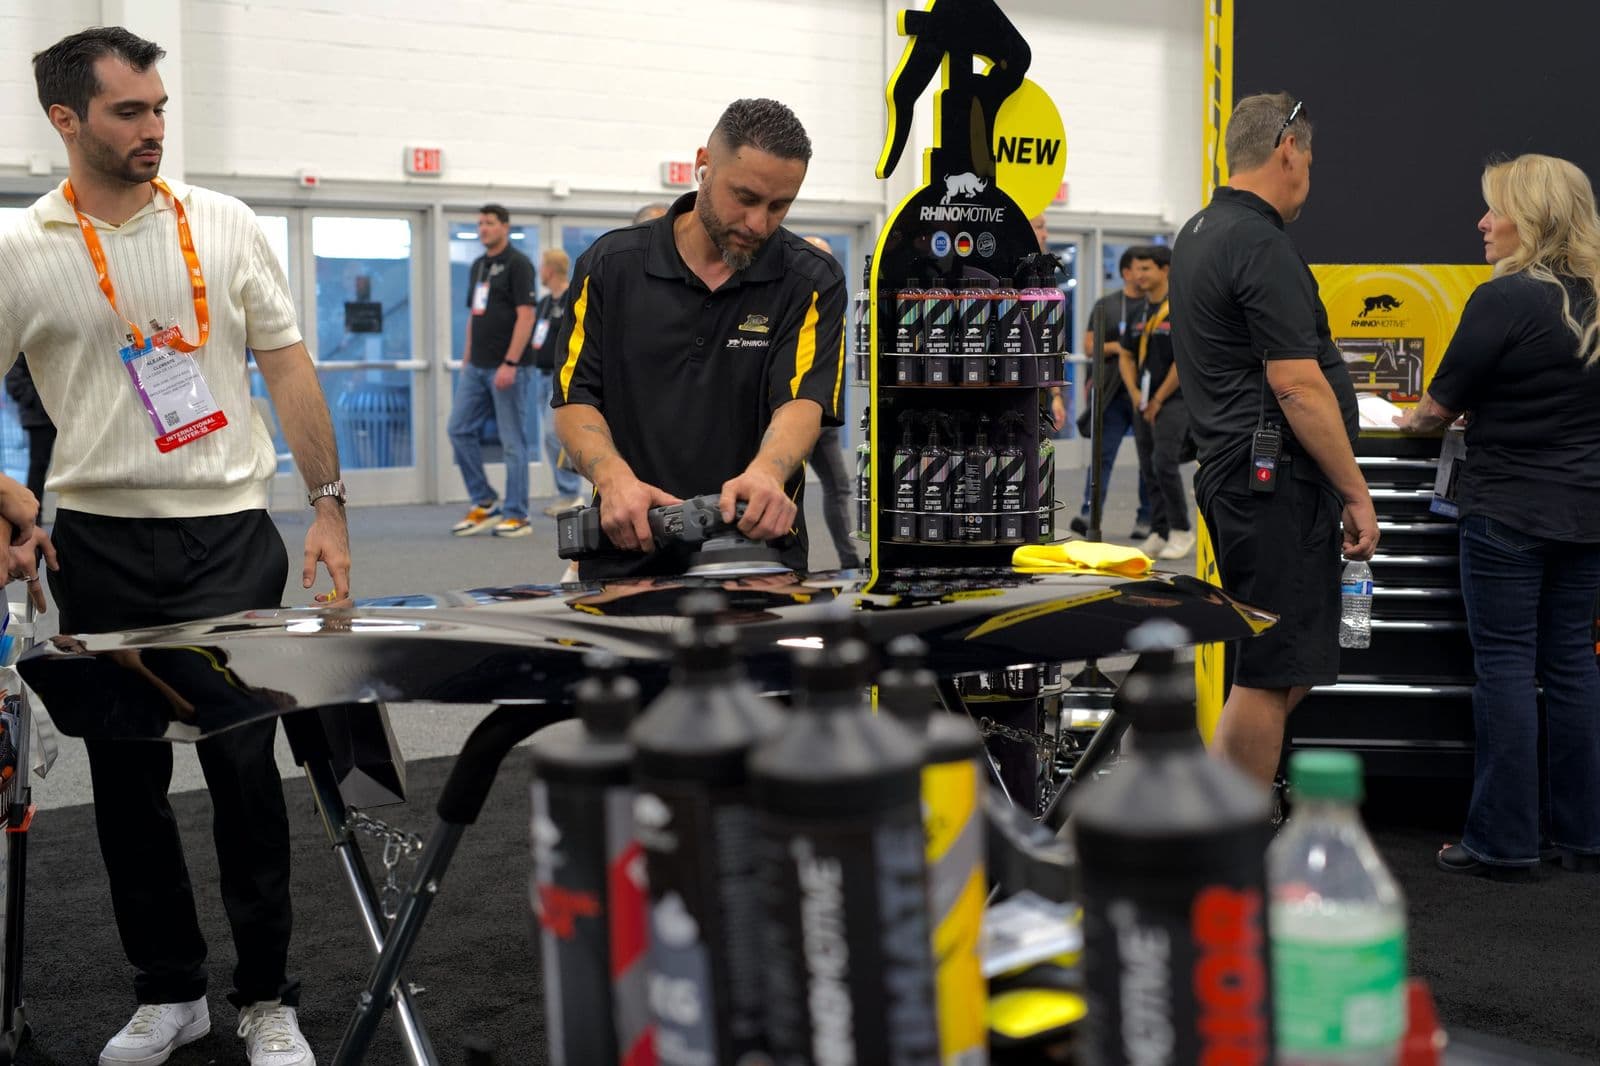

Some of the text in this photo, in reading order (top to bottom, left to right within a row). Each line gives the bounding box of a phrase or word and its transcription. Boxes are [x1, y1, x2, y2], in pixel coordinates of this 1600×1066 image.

[414, 148, 440, 171] EXIT
[997, 136, 1061, 165] NEW
[919, 205, 1005, 223] RHINOMOTIVE
[1350, 319, 1407, 329] RHINOMOTIVE
[166, 417, 215, 442] INTERNATIONAL
